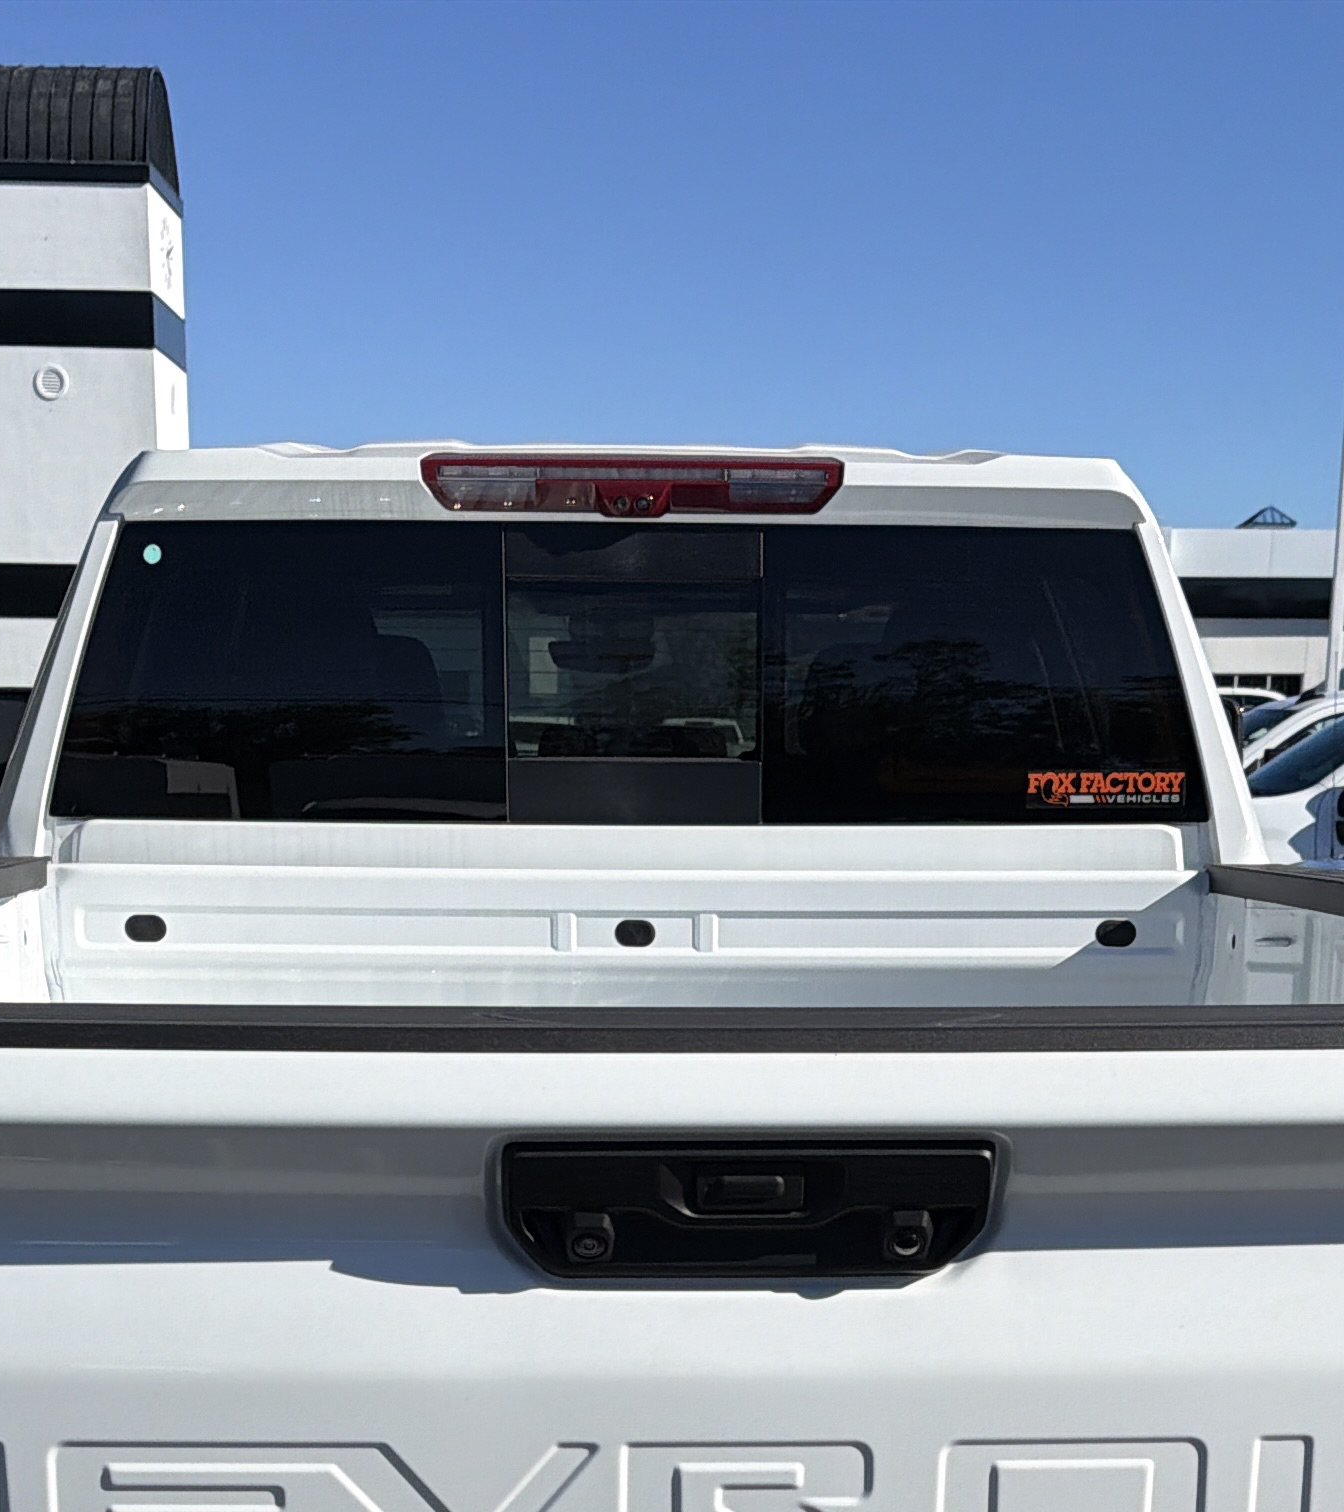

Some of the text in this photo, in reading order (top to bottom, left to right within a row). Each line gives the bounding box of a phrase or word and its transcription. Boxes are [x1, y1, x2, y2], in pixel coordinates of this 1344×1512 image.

[1027, 772, 1186, 796] FOX FACTORY
[1106, 794, 1180, 805] VEHICLES
